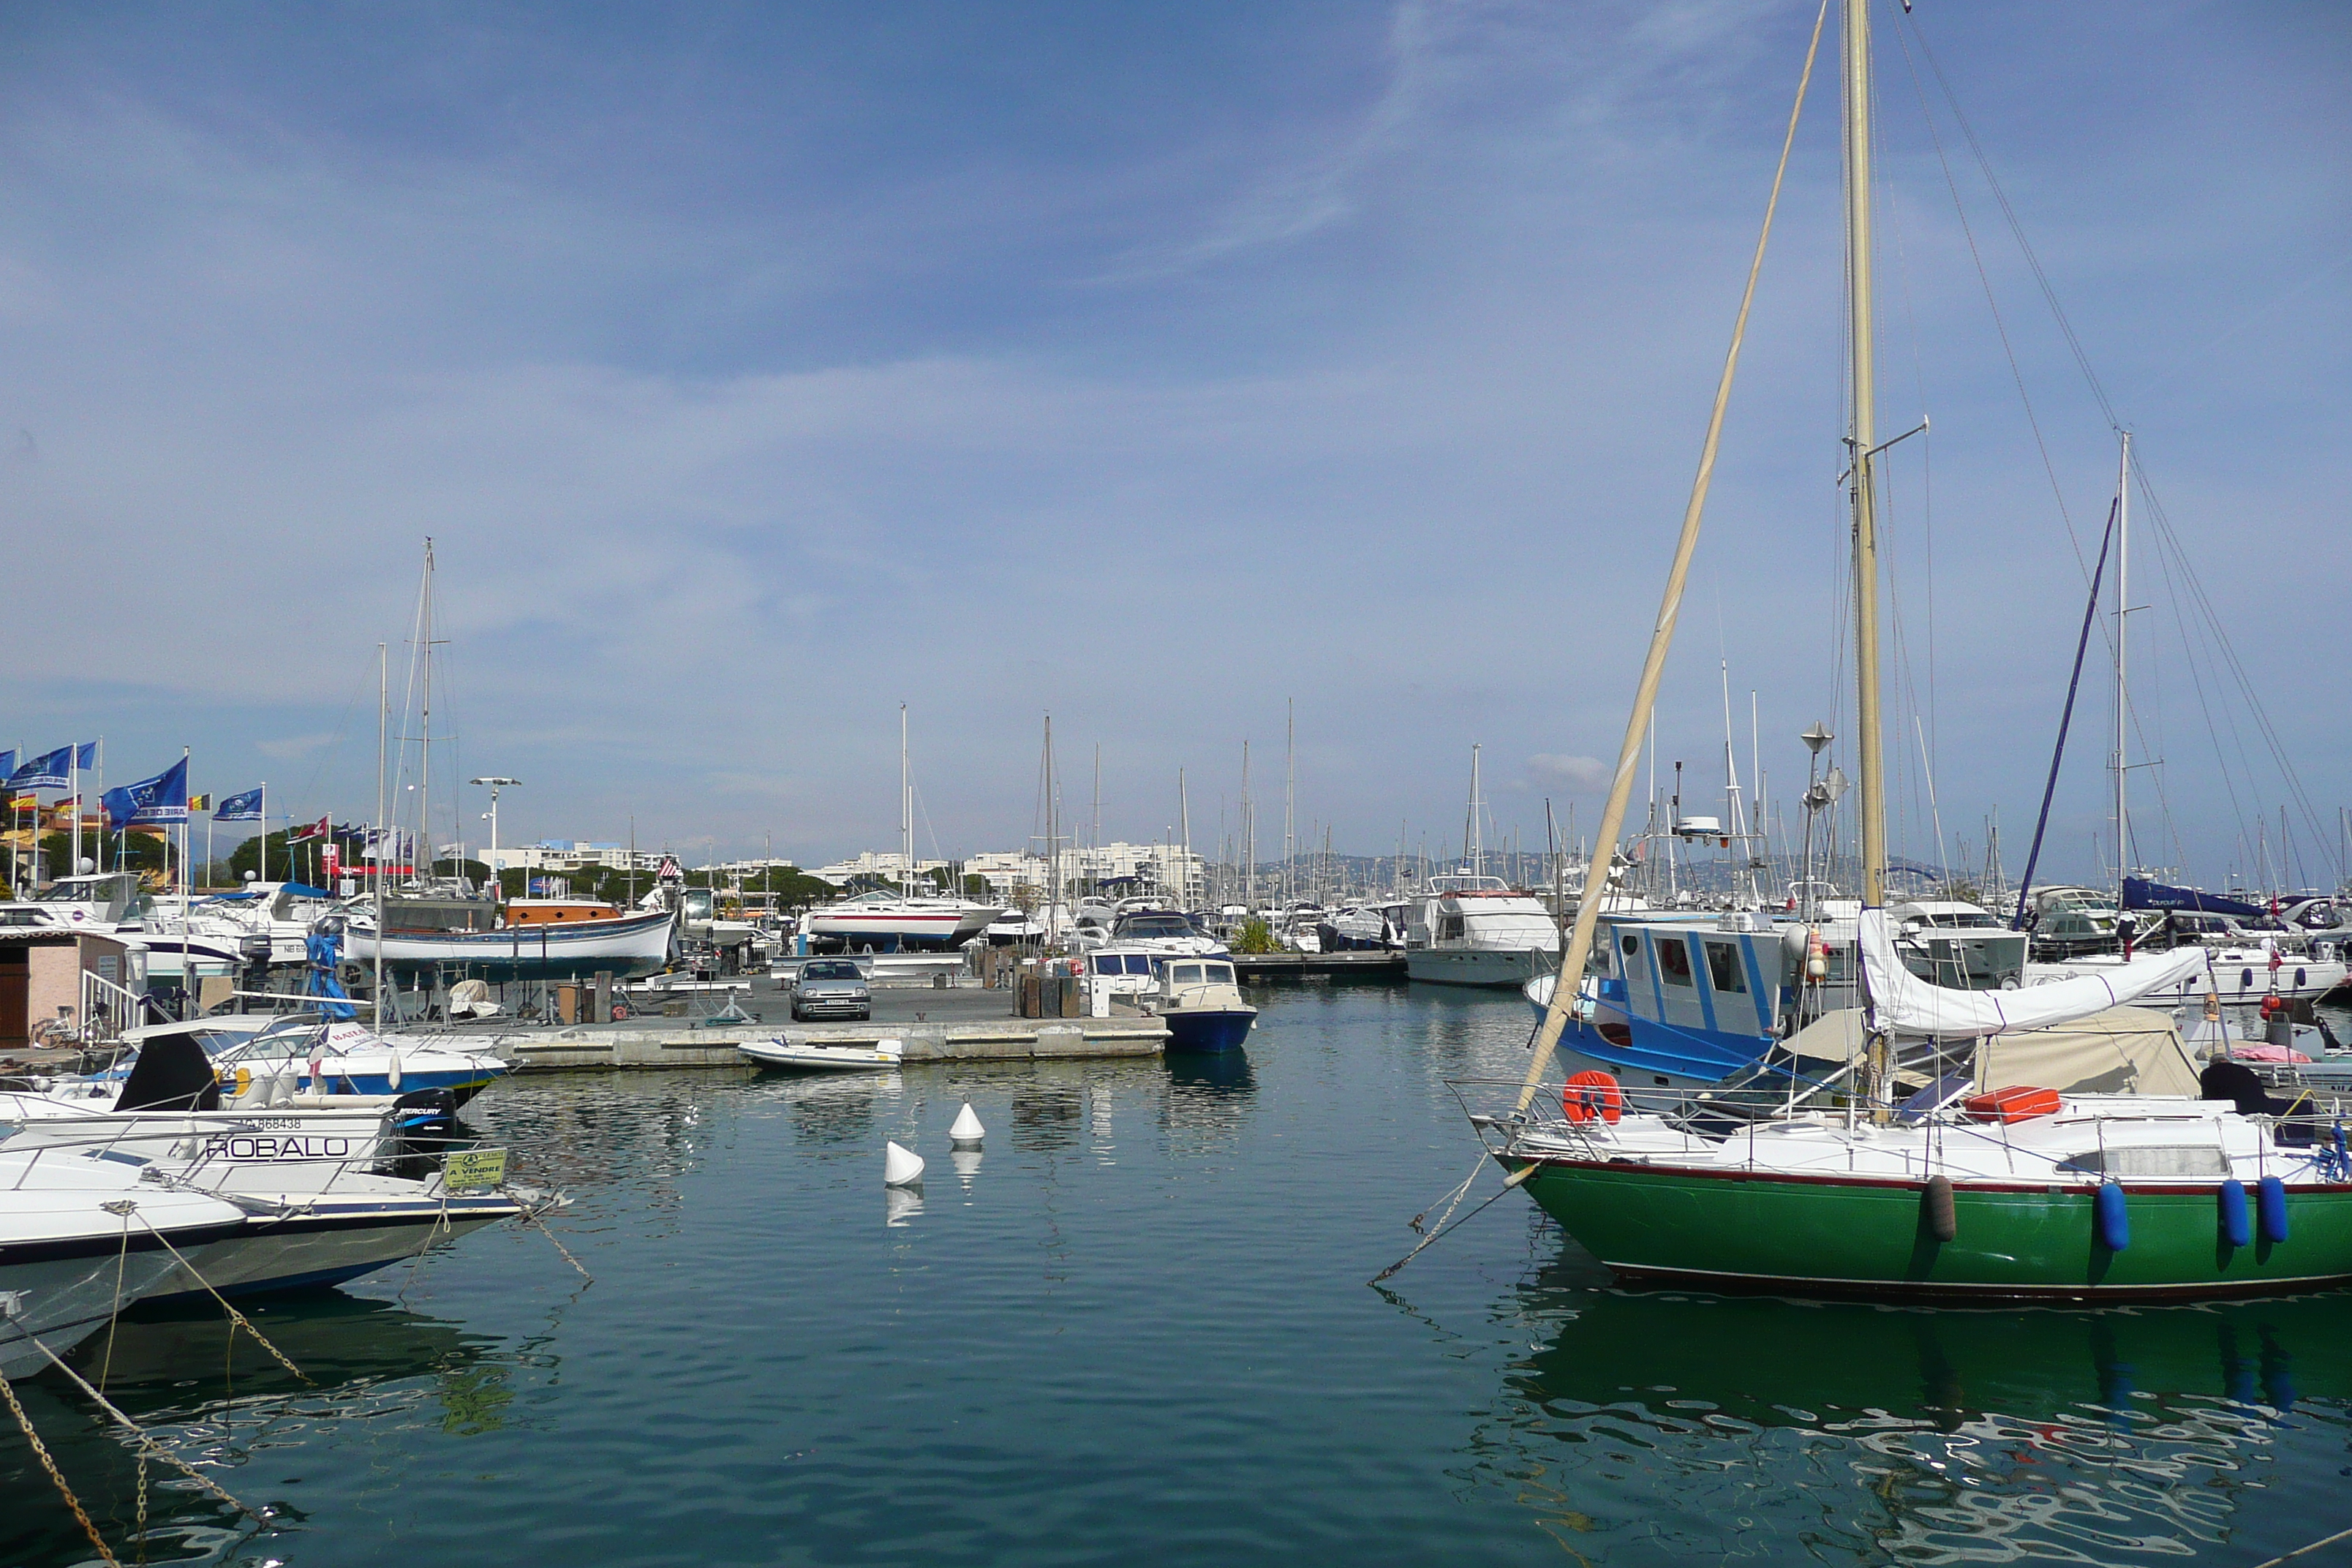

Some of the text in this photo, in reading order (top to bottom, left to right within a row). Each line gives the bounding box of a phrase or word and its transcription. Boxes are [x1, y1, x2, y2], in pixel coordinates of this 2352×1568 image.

[258, 1118, 301, 1129] 868438
[206, 1137, 348, 1158] ROBALO
[461, 1166, 500, 1175] VENDRE
